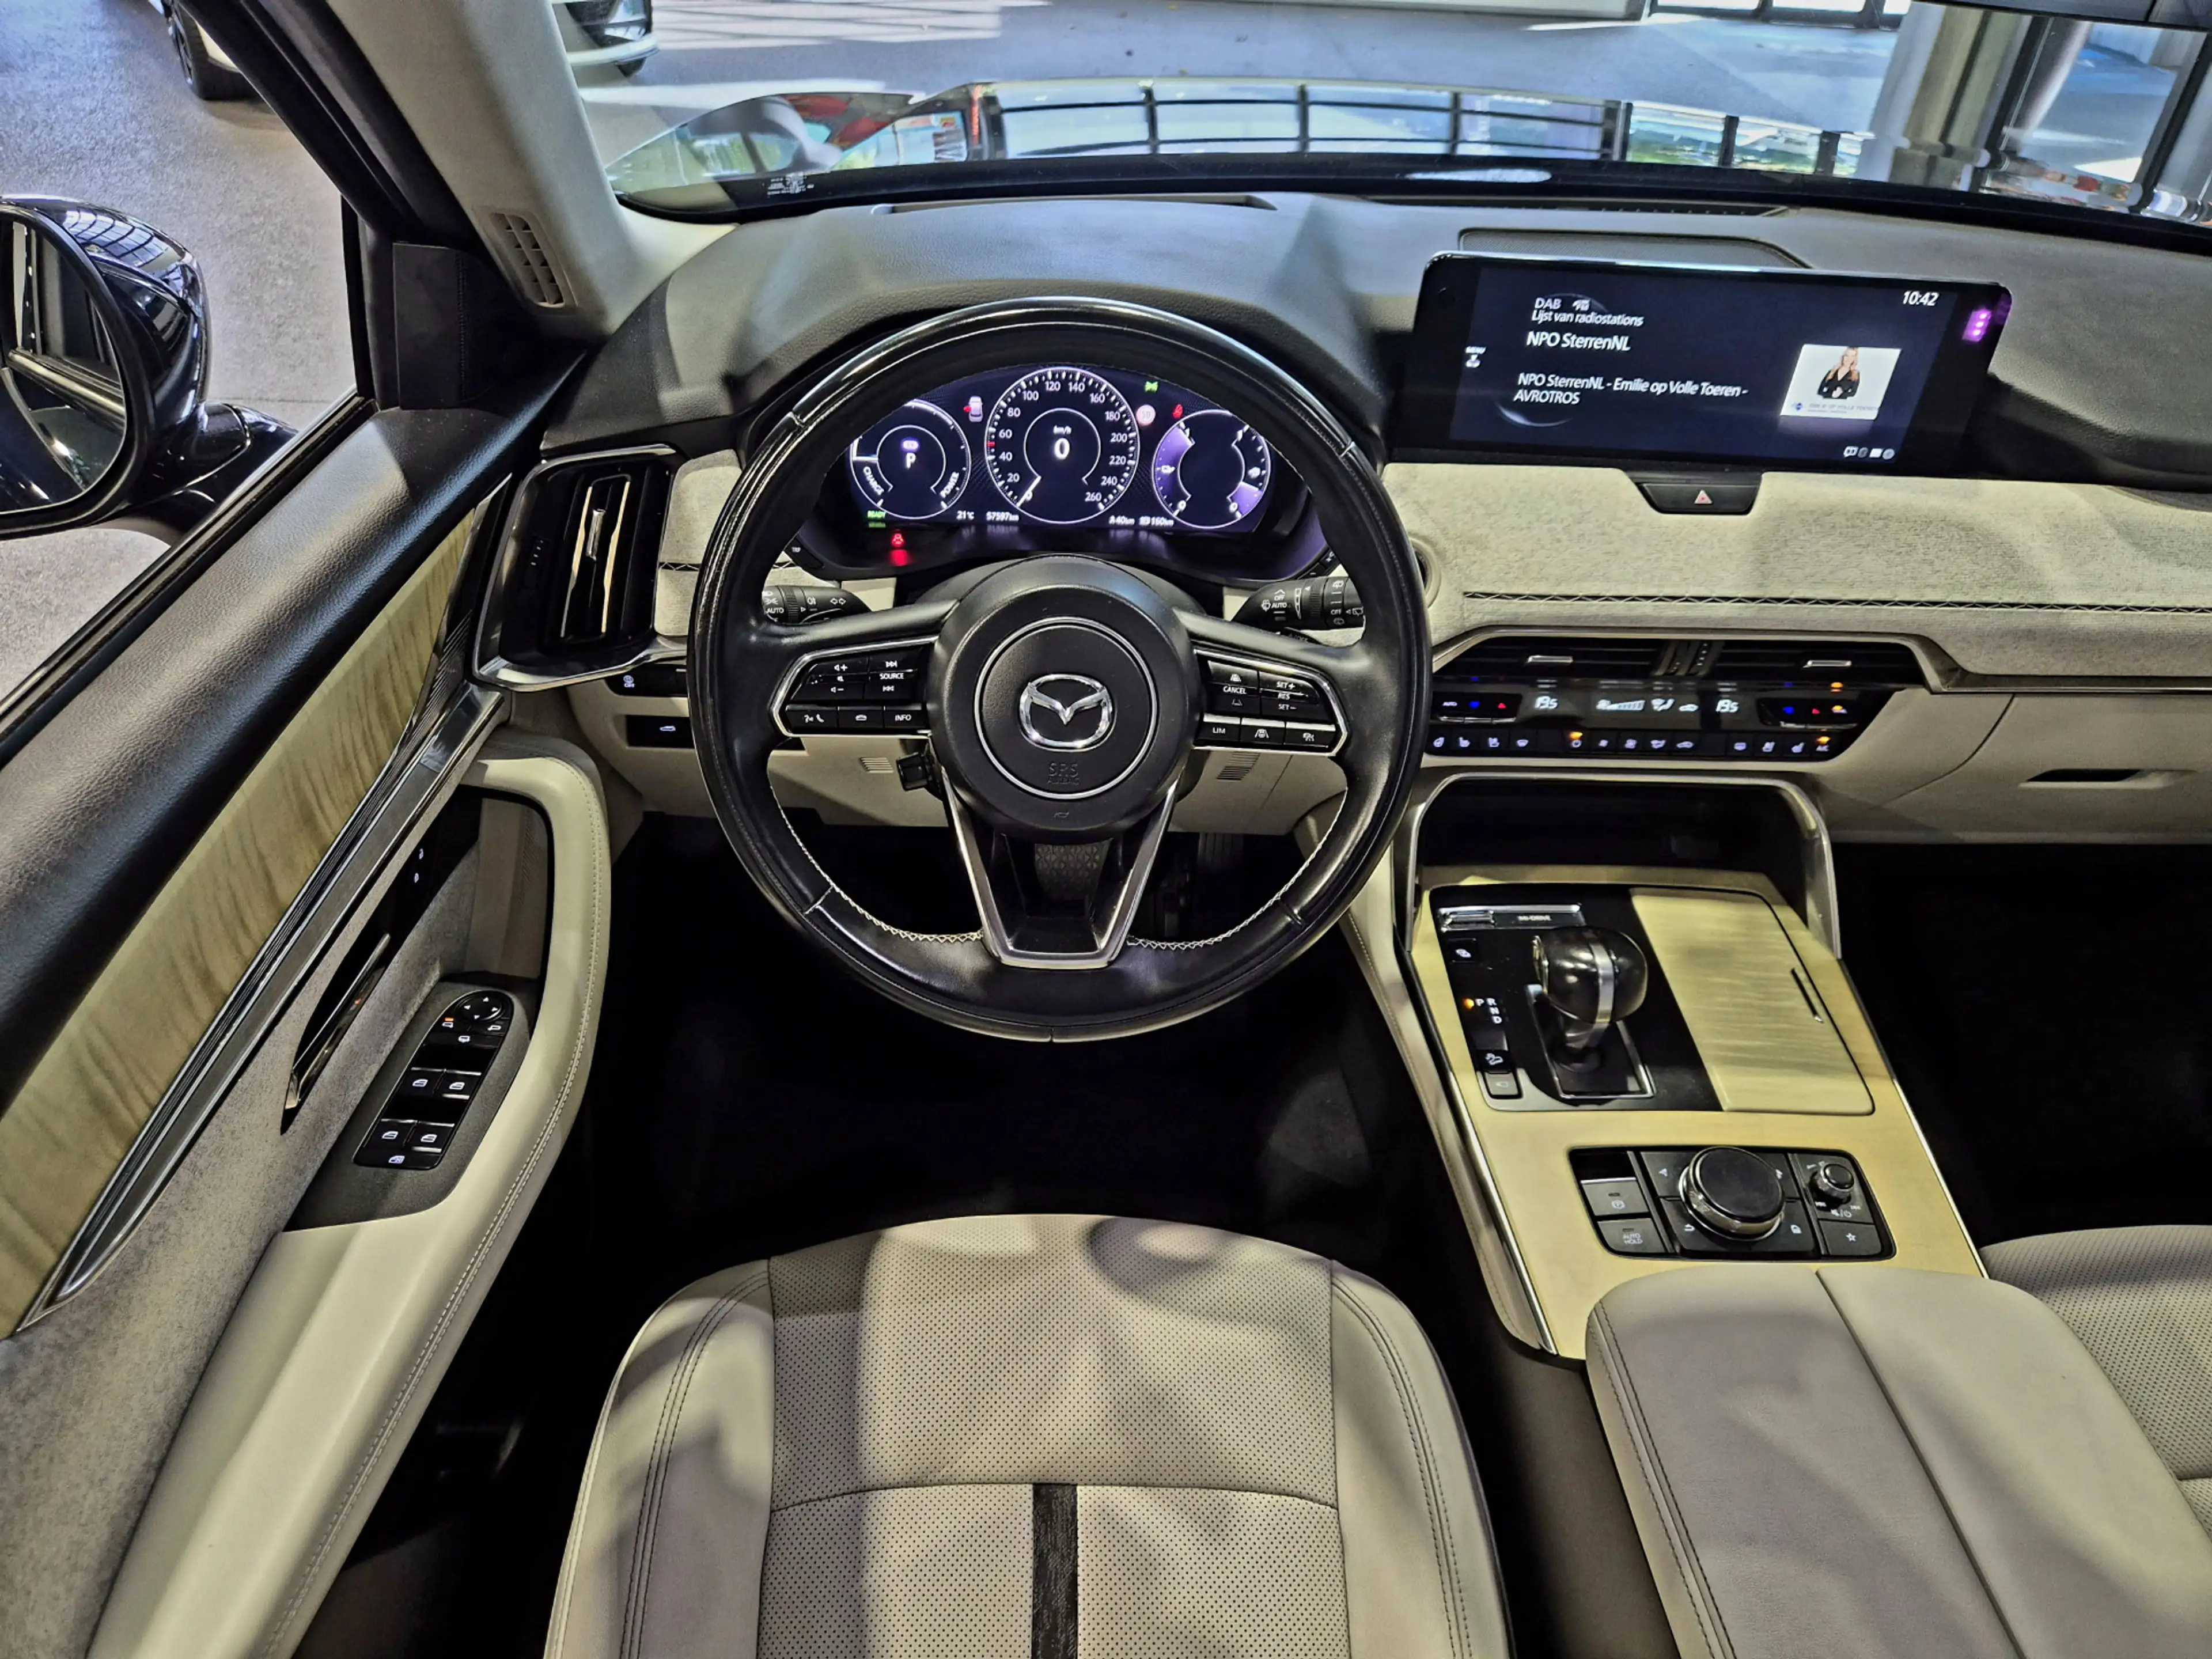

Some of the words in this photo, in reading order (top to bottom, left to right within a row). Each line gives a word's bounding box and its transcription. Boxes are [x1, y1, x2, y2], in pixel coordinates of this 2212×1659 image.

[1903, 290, 1940, 306] 10:42
[1535, 297, 1562, 310] DAB
[1532, 310, 1553, 324] Lijst
[1554, 312, 1574, 322] van
[1575, 312, 1645, 327] radiostations
[1527, 331, 1560, 347] NPO
[1562, 333, 1631, 351] SterrenNL
[1045, 381, 1060, 391] 120
[1068, 382, 1085, 392] 140
[1518, 372, 1546, 387] NPO
[1547, 374, 1605, 390] SterrenNL
[1613, 377, 1648, 392] Emilie
[1650, 381, 1668, 396] op
[1669, 381, 1699, 395] Volle
[1700, 381, 1740, 397] Toeren
[1022, 391, 1039, 401] 100
[1090, 393, 1105, 403] 160
[1514, 389, 1581, 405] AVROTROS
[1007, 407, 1021, 417] 80
[1105, 411, 1120, 421] 180
[998, 429, 1012, 439] 60
[1110, 433, 1127, 443] 200
[1054, 438, 1070, 460] 0
[906, 453, 916, 469] P
[999, 452, 1013, 462] 40
[1109, 456, 1126, 465] 220
[1007, 473, 1020, 483] 20
[1101, 476, 1118, 486] 240
[1085, 492, 1102, 502] 260
[1177, 500, 1187, 512] 0
[1229, 502, 1239, 513] 0
[1223, 686, 1247, 695] CANCEL
[1475, 999, 1484, 1007] P
[1487, 998, 1496, 1006] R
[1493, 1016, 1502, 1024] D
